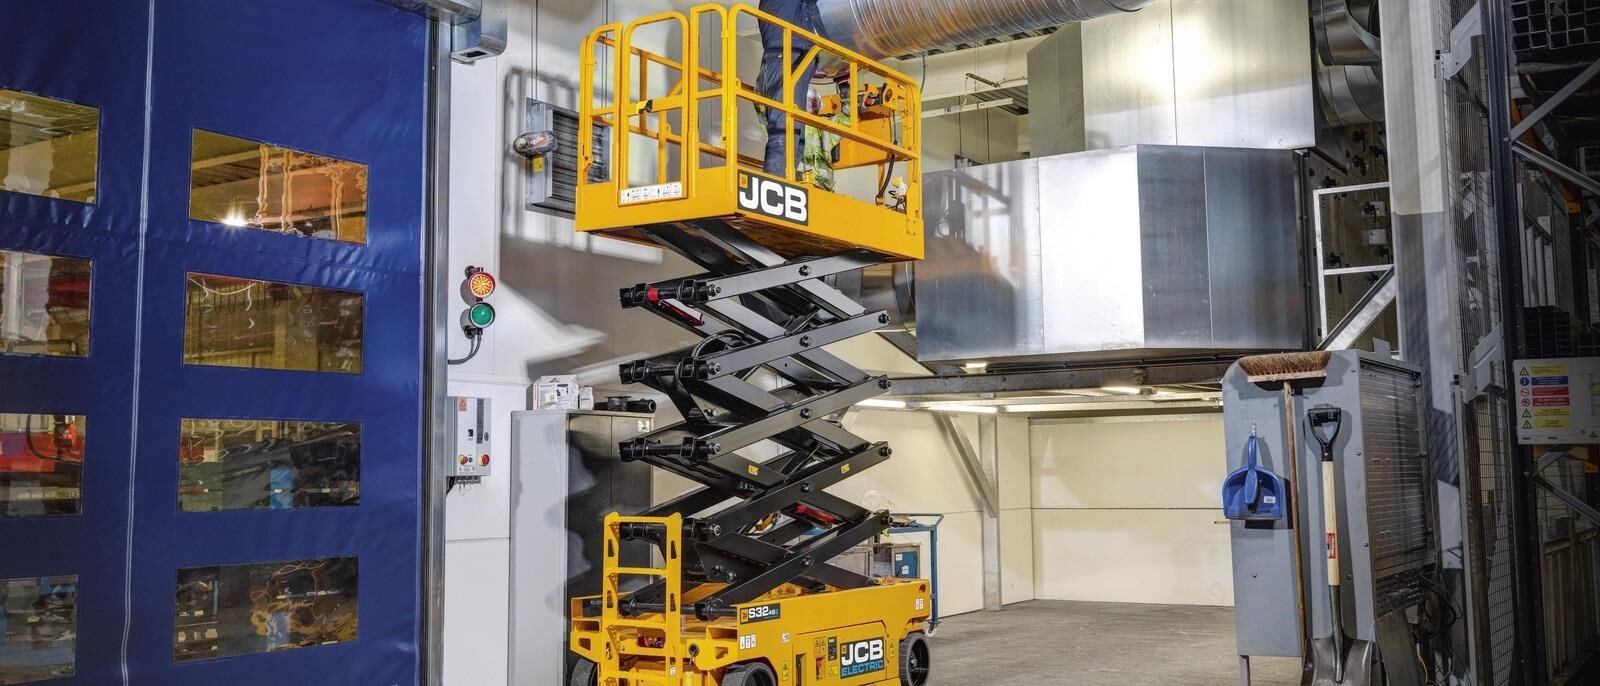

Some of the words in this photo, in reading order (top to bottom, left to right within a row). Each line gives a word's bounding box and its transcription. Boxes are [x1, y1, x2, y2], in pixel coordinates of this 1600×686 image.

[739, 176, 808, 222] JCB
[841, 639, 884, 666] JCB
[841, 660, 884, 677] ELECTRIC
